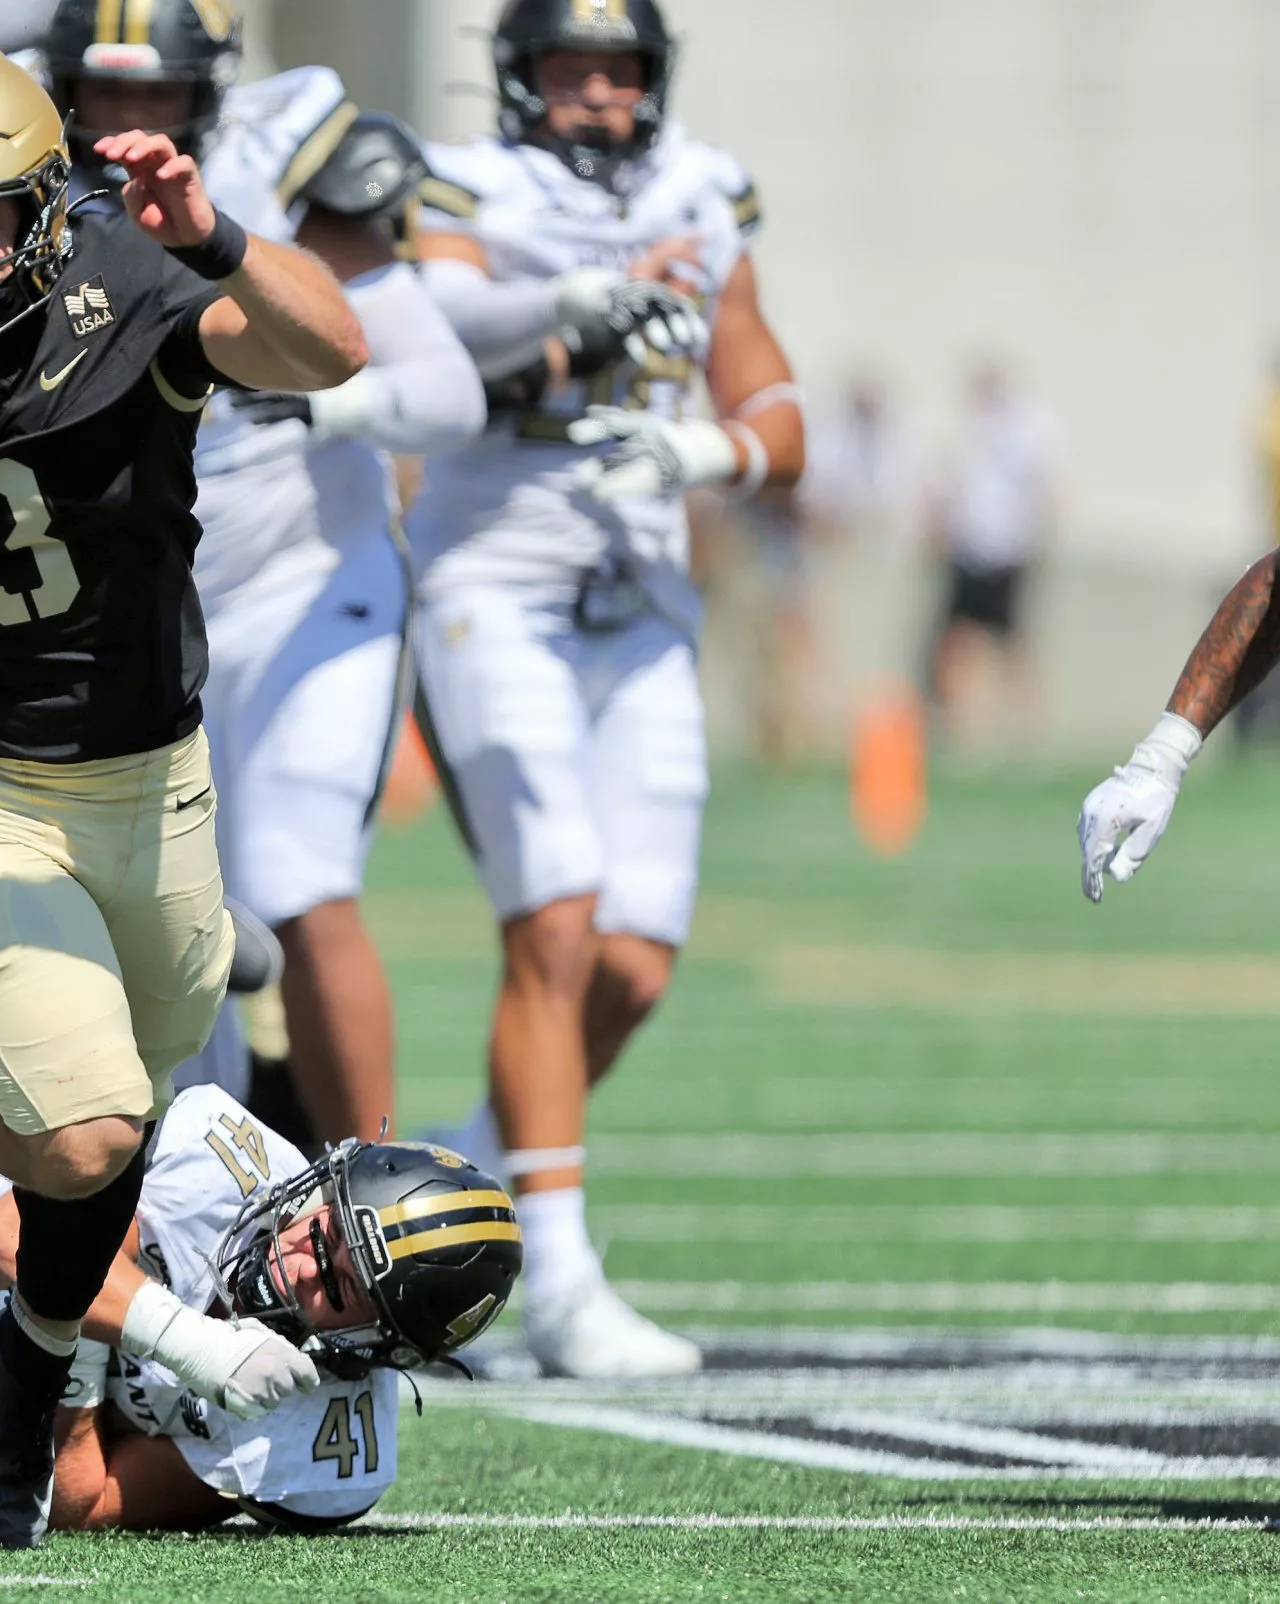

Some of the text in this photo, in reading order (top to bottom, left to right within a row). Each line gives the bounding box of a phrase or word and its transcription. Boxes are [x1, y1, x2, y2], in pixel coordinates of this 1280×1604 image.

[73, 308, 114, 335] USAA
[204, 1112, 271, 1200] 41
[362, 1214, 384, 1264] BULLDOGS
[312, 1390, 379, 1480] 41
